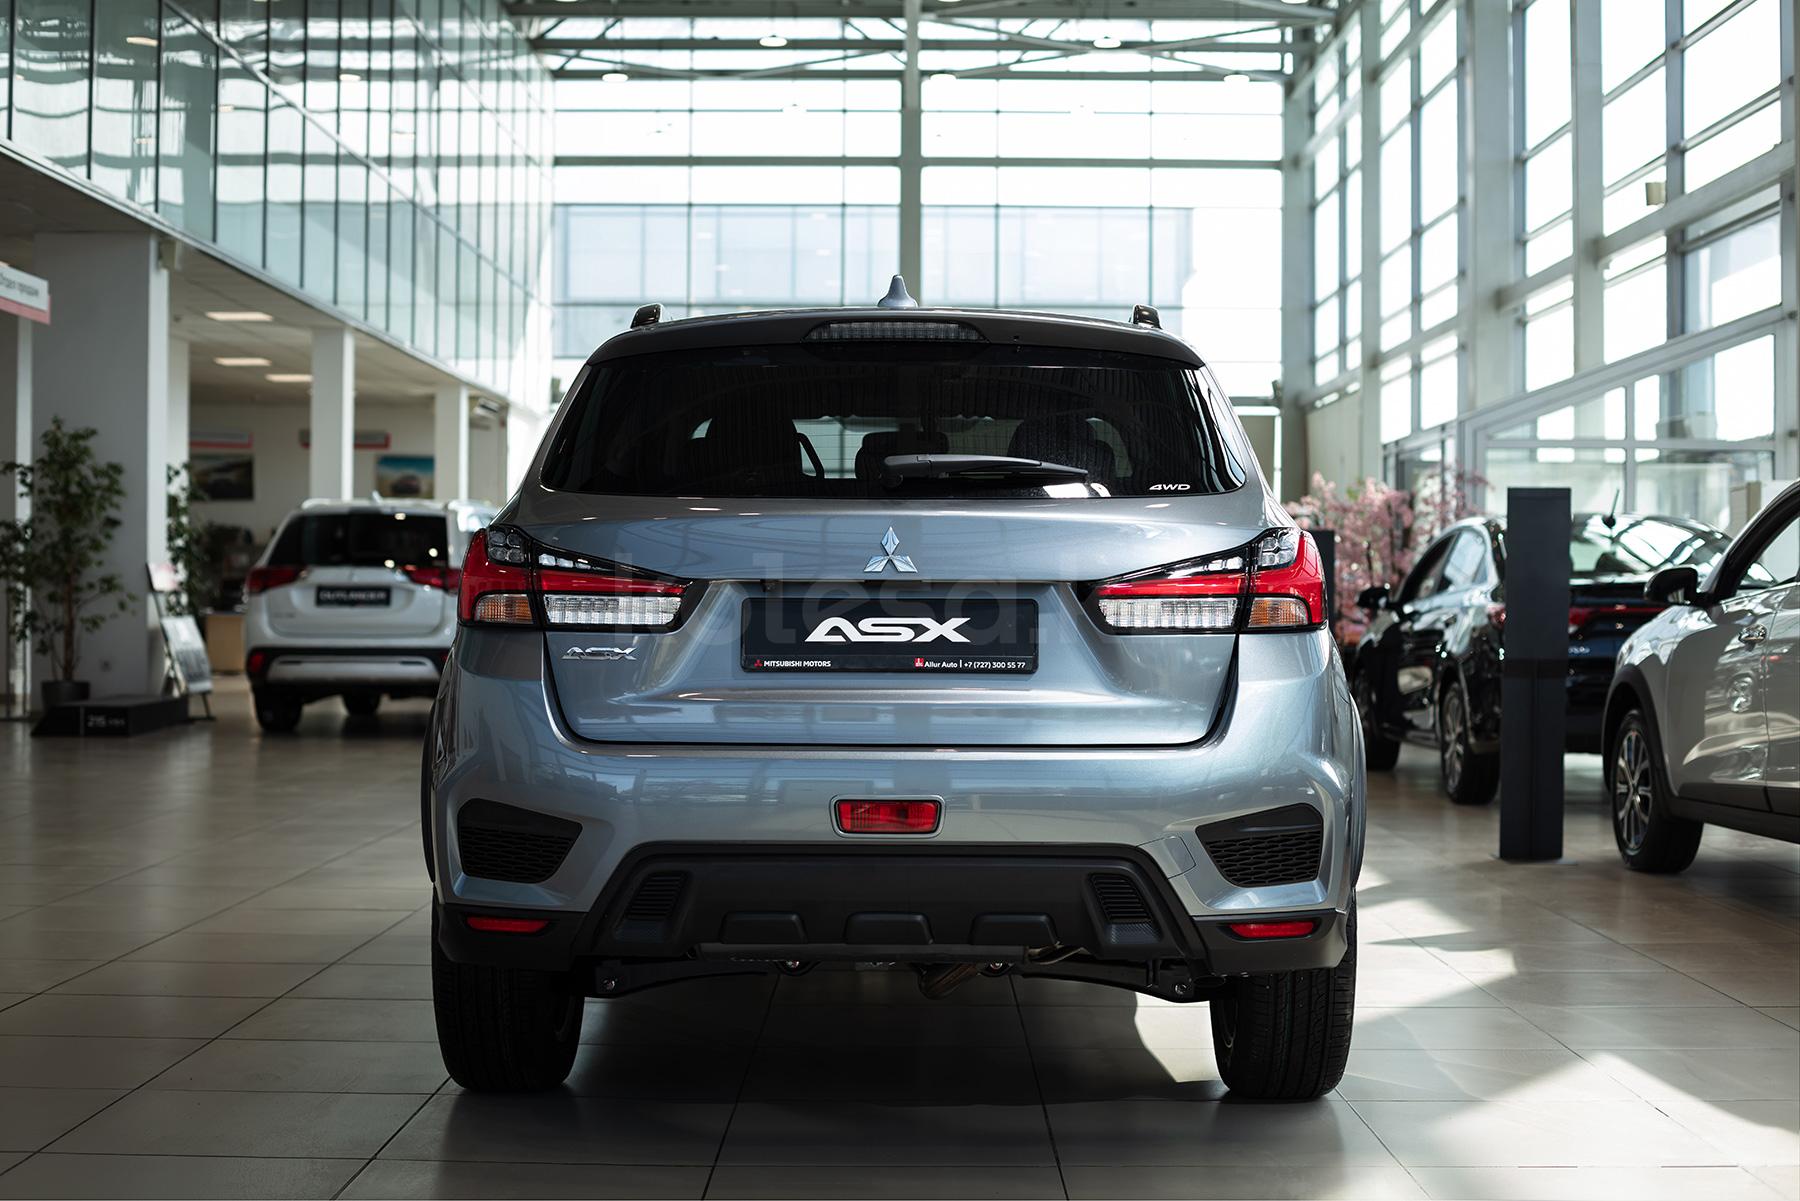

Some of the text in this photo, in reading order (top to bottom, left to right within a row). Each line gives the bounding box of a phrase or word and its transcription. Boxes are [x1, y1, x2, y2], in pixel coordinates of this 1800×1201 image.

[1148, 483, 1191, 491] 4WD
[804, 616, 972, 643] ASX
[561, 646, 637, 660] ASX
[973, 661, 991, 669] (727)
[992, 661, 1006, 669] 300
